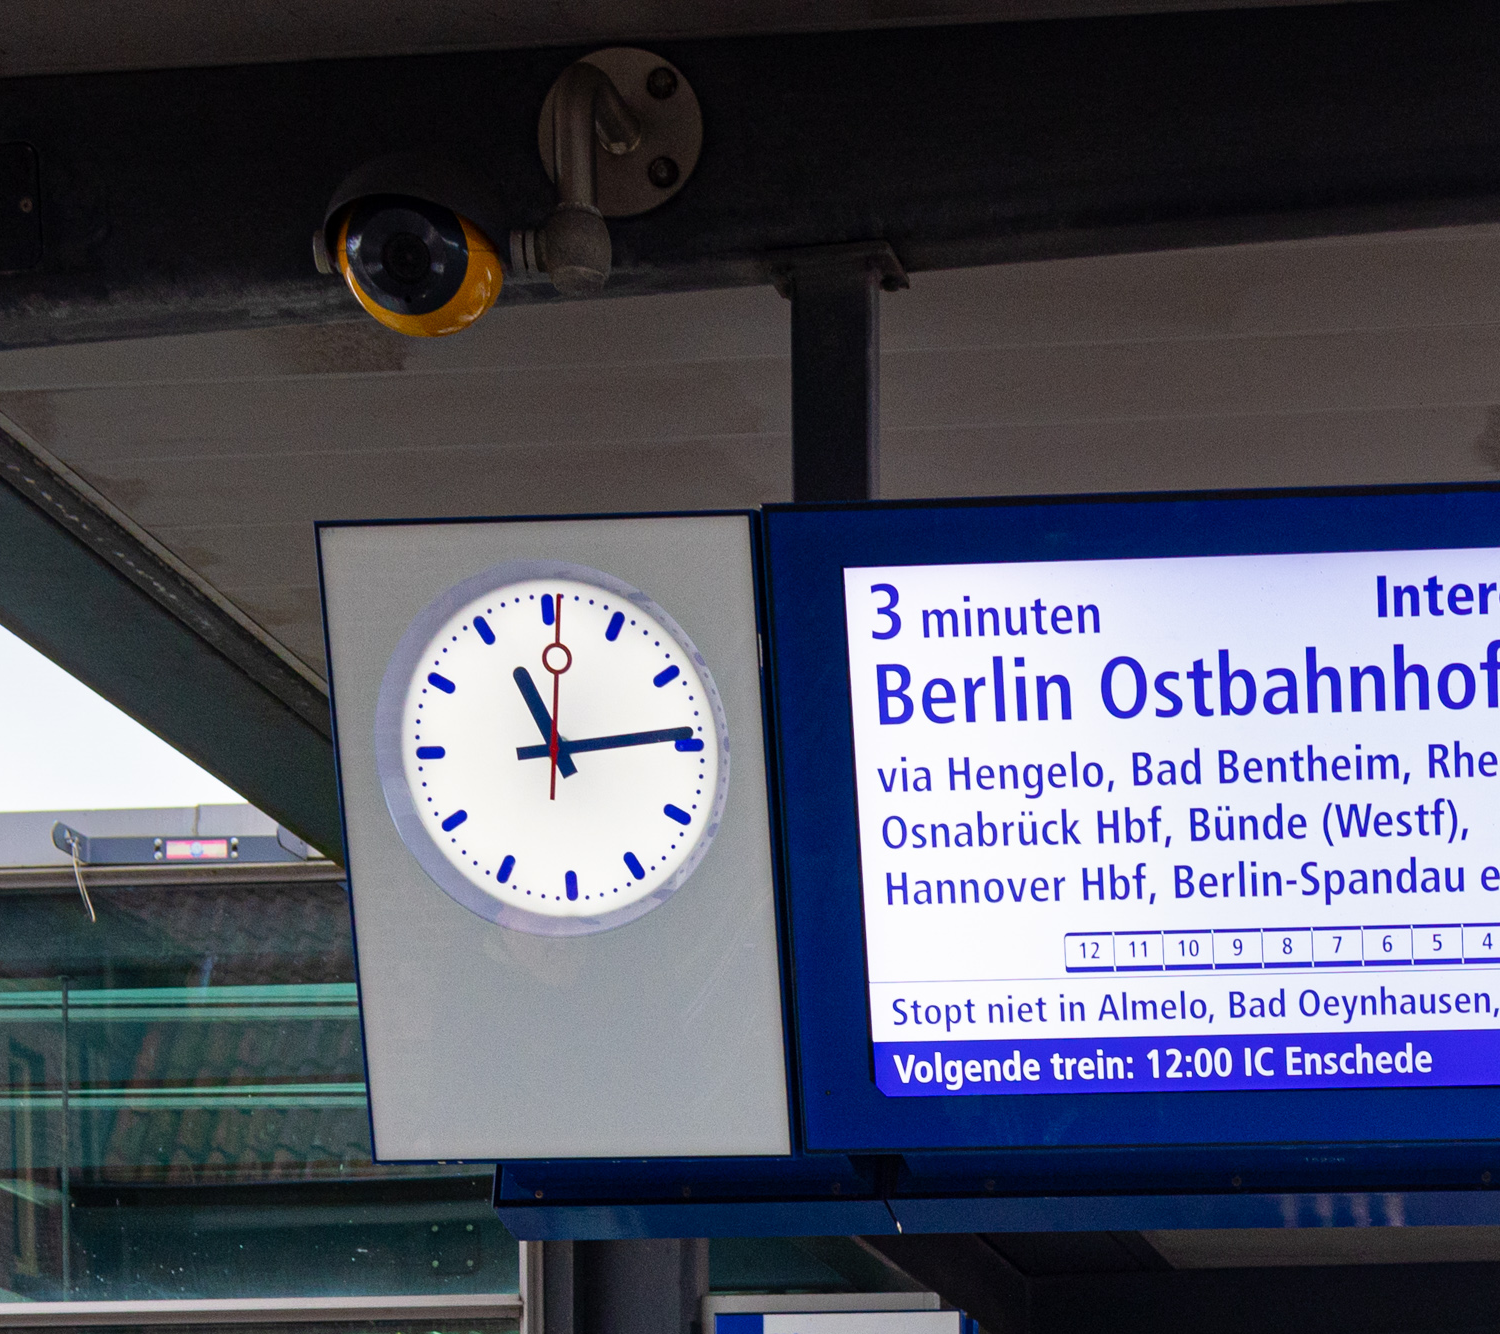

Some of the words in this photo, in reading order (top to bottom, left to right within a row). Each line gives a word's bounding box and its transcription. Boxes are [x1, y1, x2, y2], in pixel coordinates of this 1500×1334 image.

[871, 583, 901, 640] 3
[922, 596, 1100, 638] minuten
[876, 656, 1072, 725] Berlin
[877, 757, 931, 792] via
[949, 751, 1114, 799] Hengelo,
[1132, 748, 1201, 786] Bad
[1218, 744, 1410, 785] Bentheim,
[883, 809, 1081, 849] Osnabrück
[1097, 806, 1171, 848] Hbf,
[1190, 803, 1307, 841] Bünde
[1323, 798, 1468, 846] (Westf),
[886, 872, 1065, 905] Hannover
[1082, 863, 1155, 904] Hbf,
[1174, 857, 1464, 905] Berlin-Spandau
[1080, 942, 1099, 958] 12
[1130, 941, 1147, 957] 11
[1179, 940, 1199, 956] 10
[1233, 939, 1242, 956] 9
[1283, 938, 1292, 954] 8
[1333, 936, 1342, 953] 7
[1383, 935, 1392, 952] 6
[1433, 934, 1442, 951] 5
[1483, 933, 1492, 949] 4
[893, 999, 975, 1032] Stopt
[989, 995, 1047, 1023] niet
[1060, 994, 1085, 1021] in
[1099, 991, 1214, 1023] Almelo,
[1229, 988, 1285, 1018] Bad
[1299, 985, 1500, 1024] Oeynhausen,
[893, 1050, 1040, 1090] Volgende
[1050, 1049, 1133, 1080] trein:
[1147, 1048, 1232, 1078] 12:00
[1245, 1047, 1274, 1076] IC
[1286, 1043, 1432, 1075] Enschede
